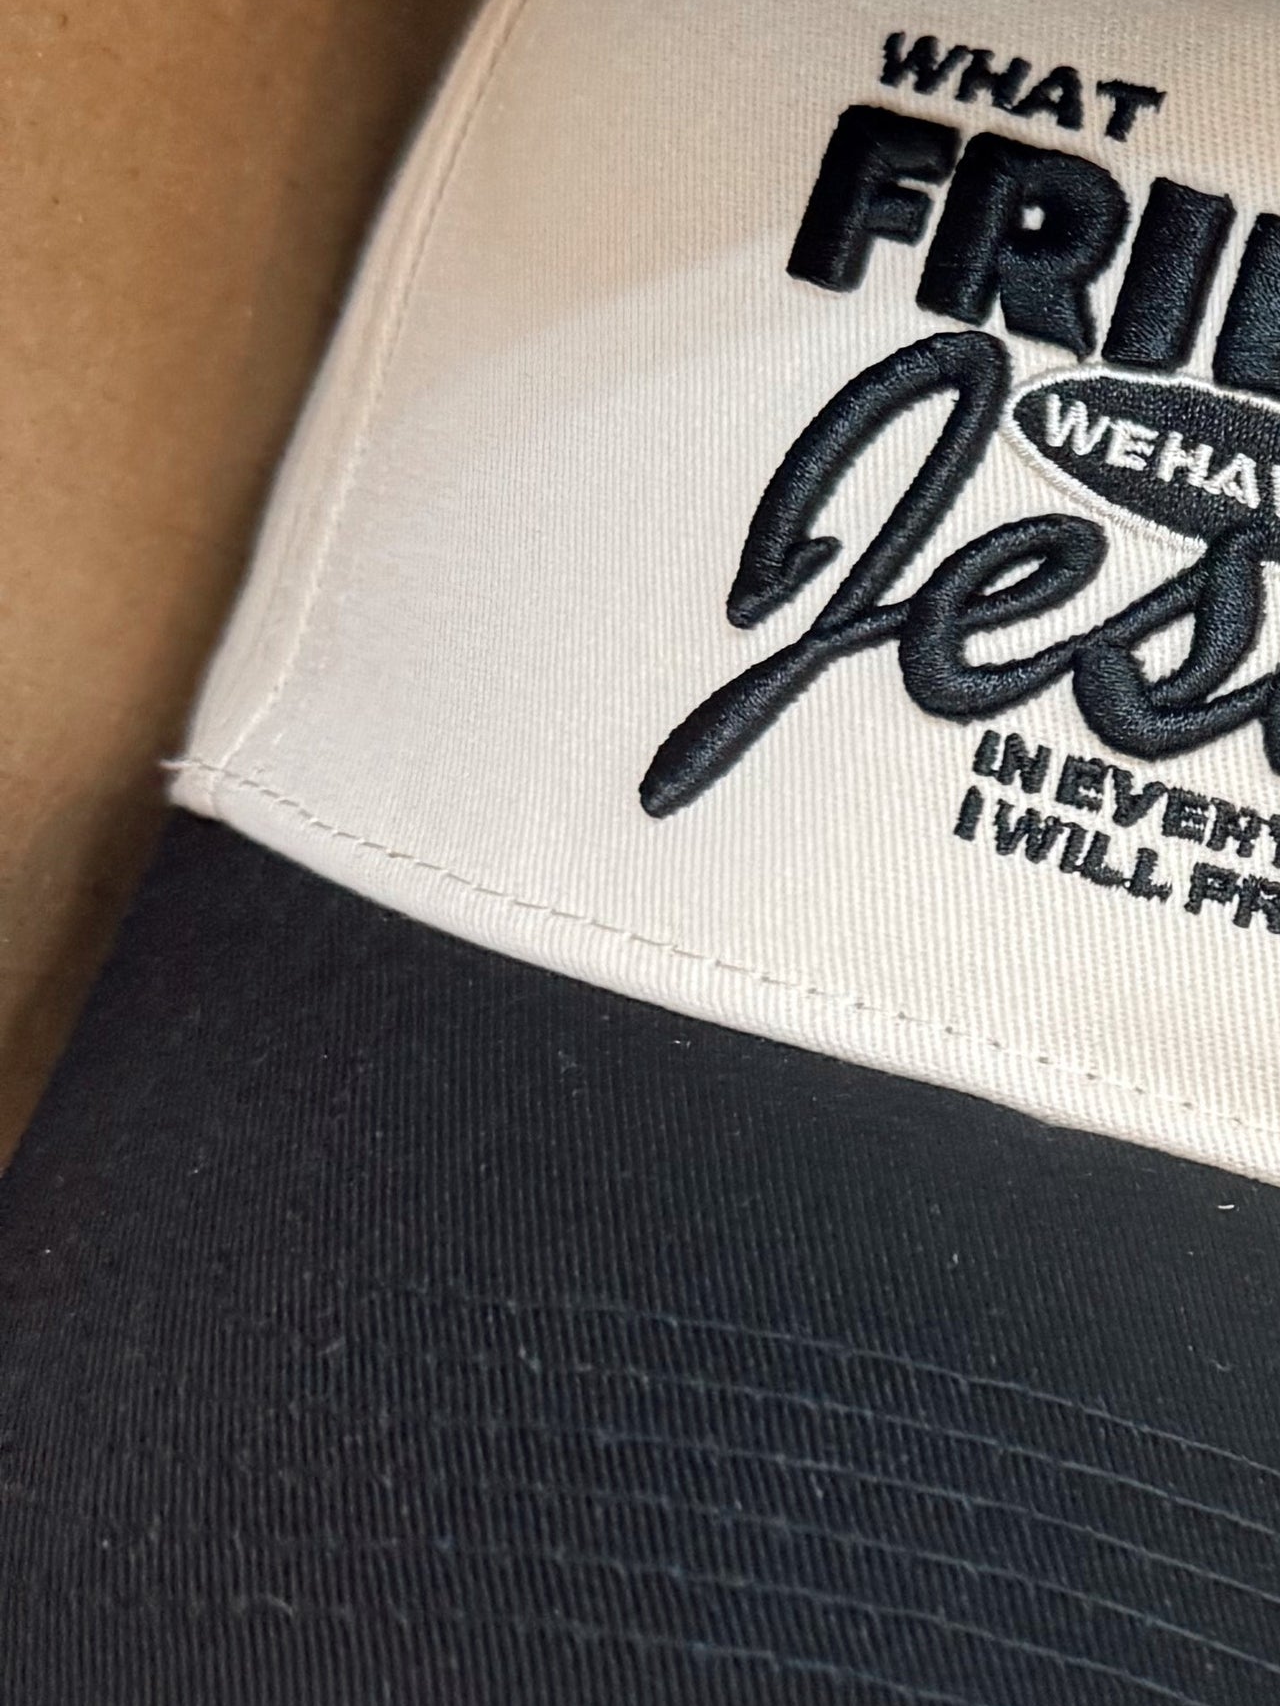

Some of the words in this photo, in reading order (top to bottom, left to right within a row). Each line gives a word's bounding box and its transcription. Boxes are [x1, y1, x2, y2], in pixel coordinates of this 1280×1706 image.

[879, 30, 1166, 142] WHAT
[972, 729, 1052, 795] IN
[953, 785, 984, 841] I
[993, 797, 1174, 903] WILL
